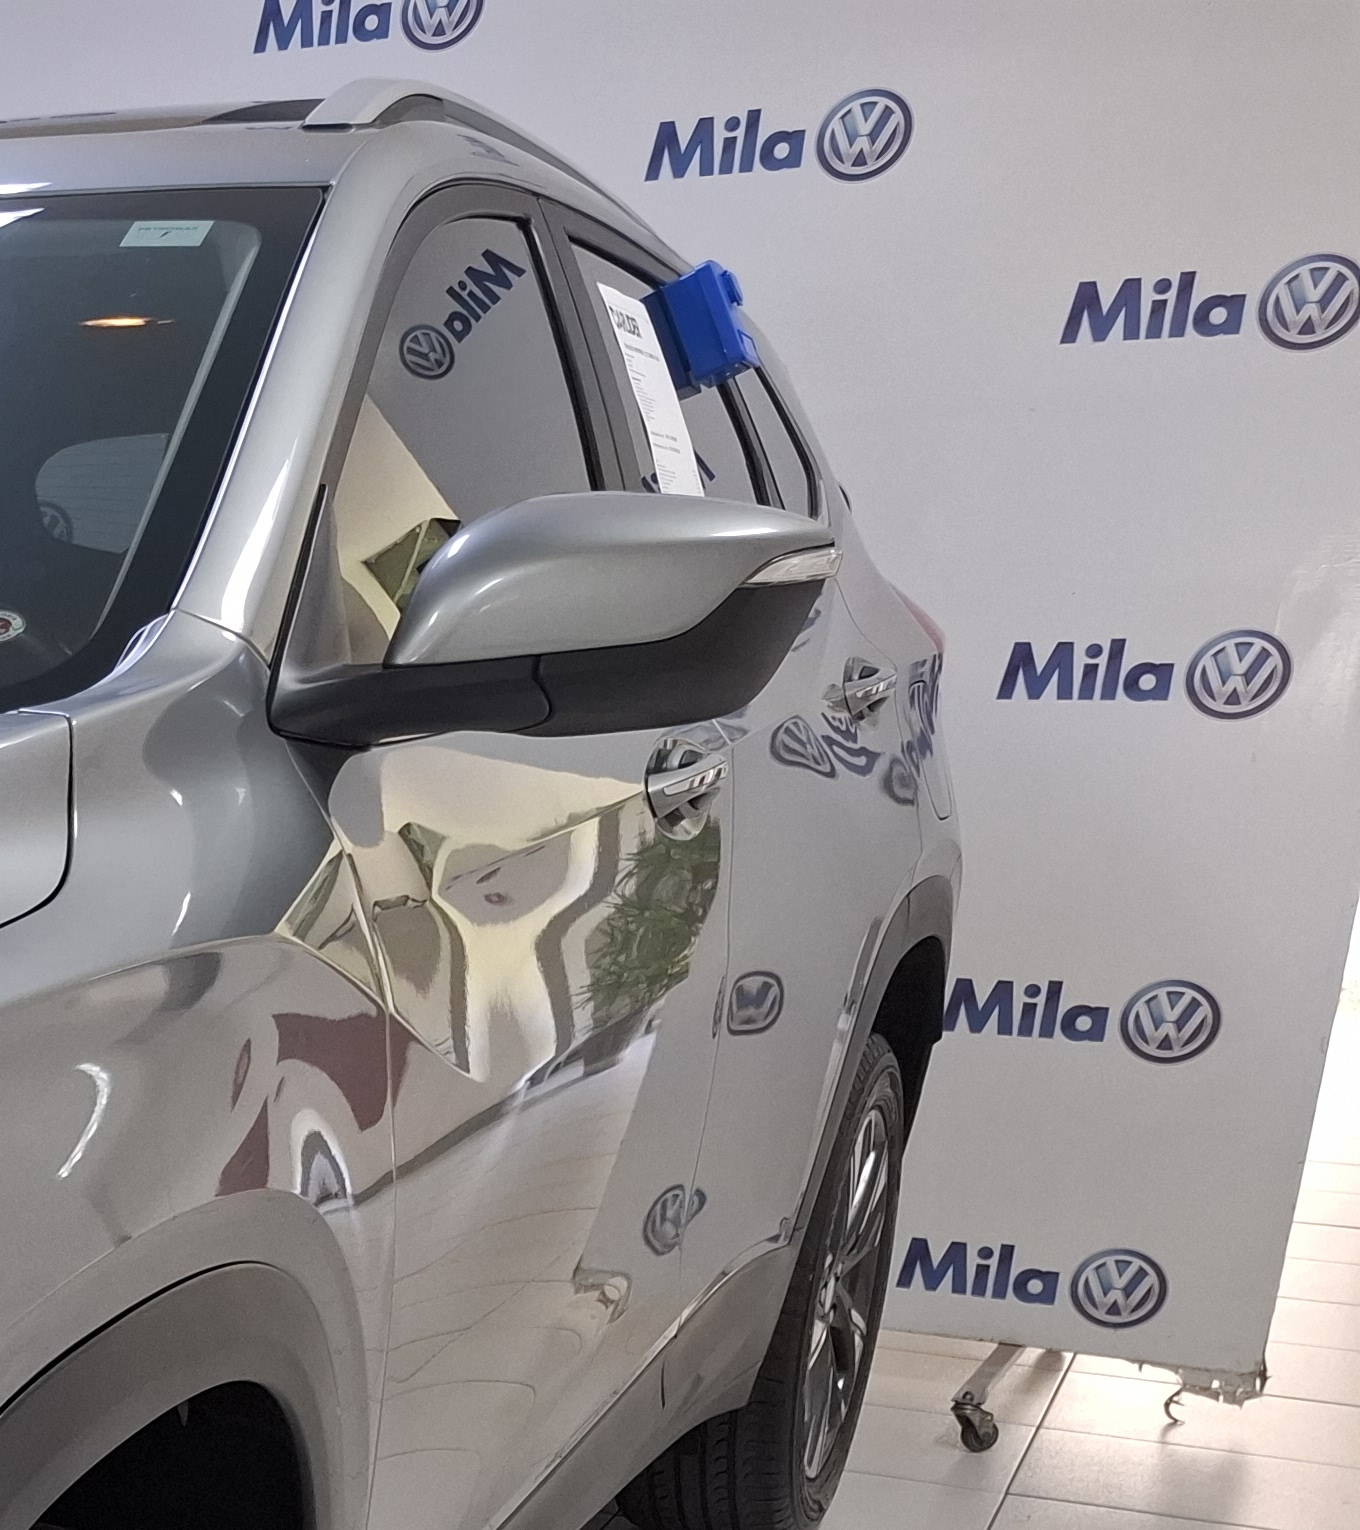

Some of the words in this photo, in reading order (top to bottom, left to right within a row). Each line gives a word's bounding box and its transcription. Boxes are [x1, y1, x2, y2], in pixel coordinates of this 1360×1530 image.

[253, 0, 392, 54] Mila
[644, 109, 806, 181] Mila
[1060, 271, 1247, 344] Mila
[996, 638, 1175, 701] Mila
[943, 977, 1109, 1042] Mila
[896, 1237, 1060, 1305] Mila
